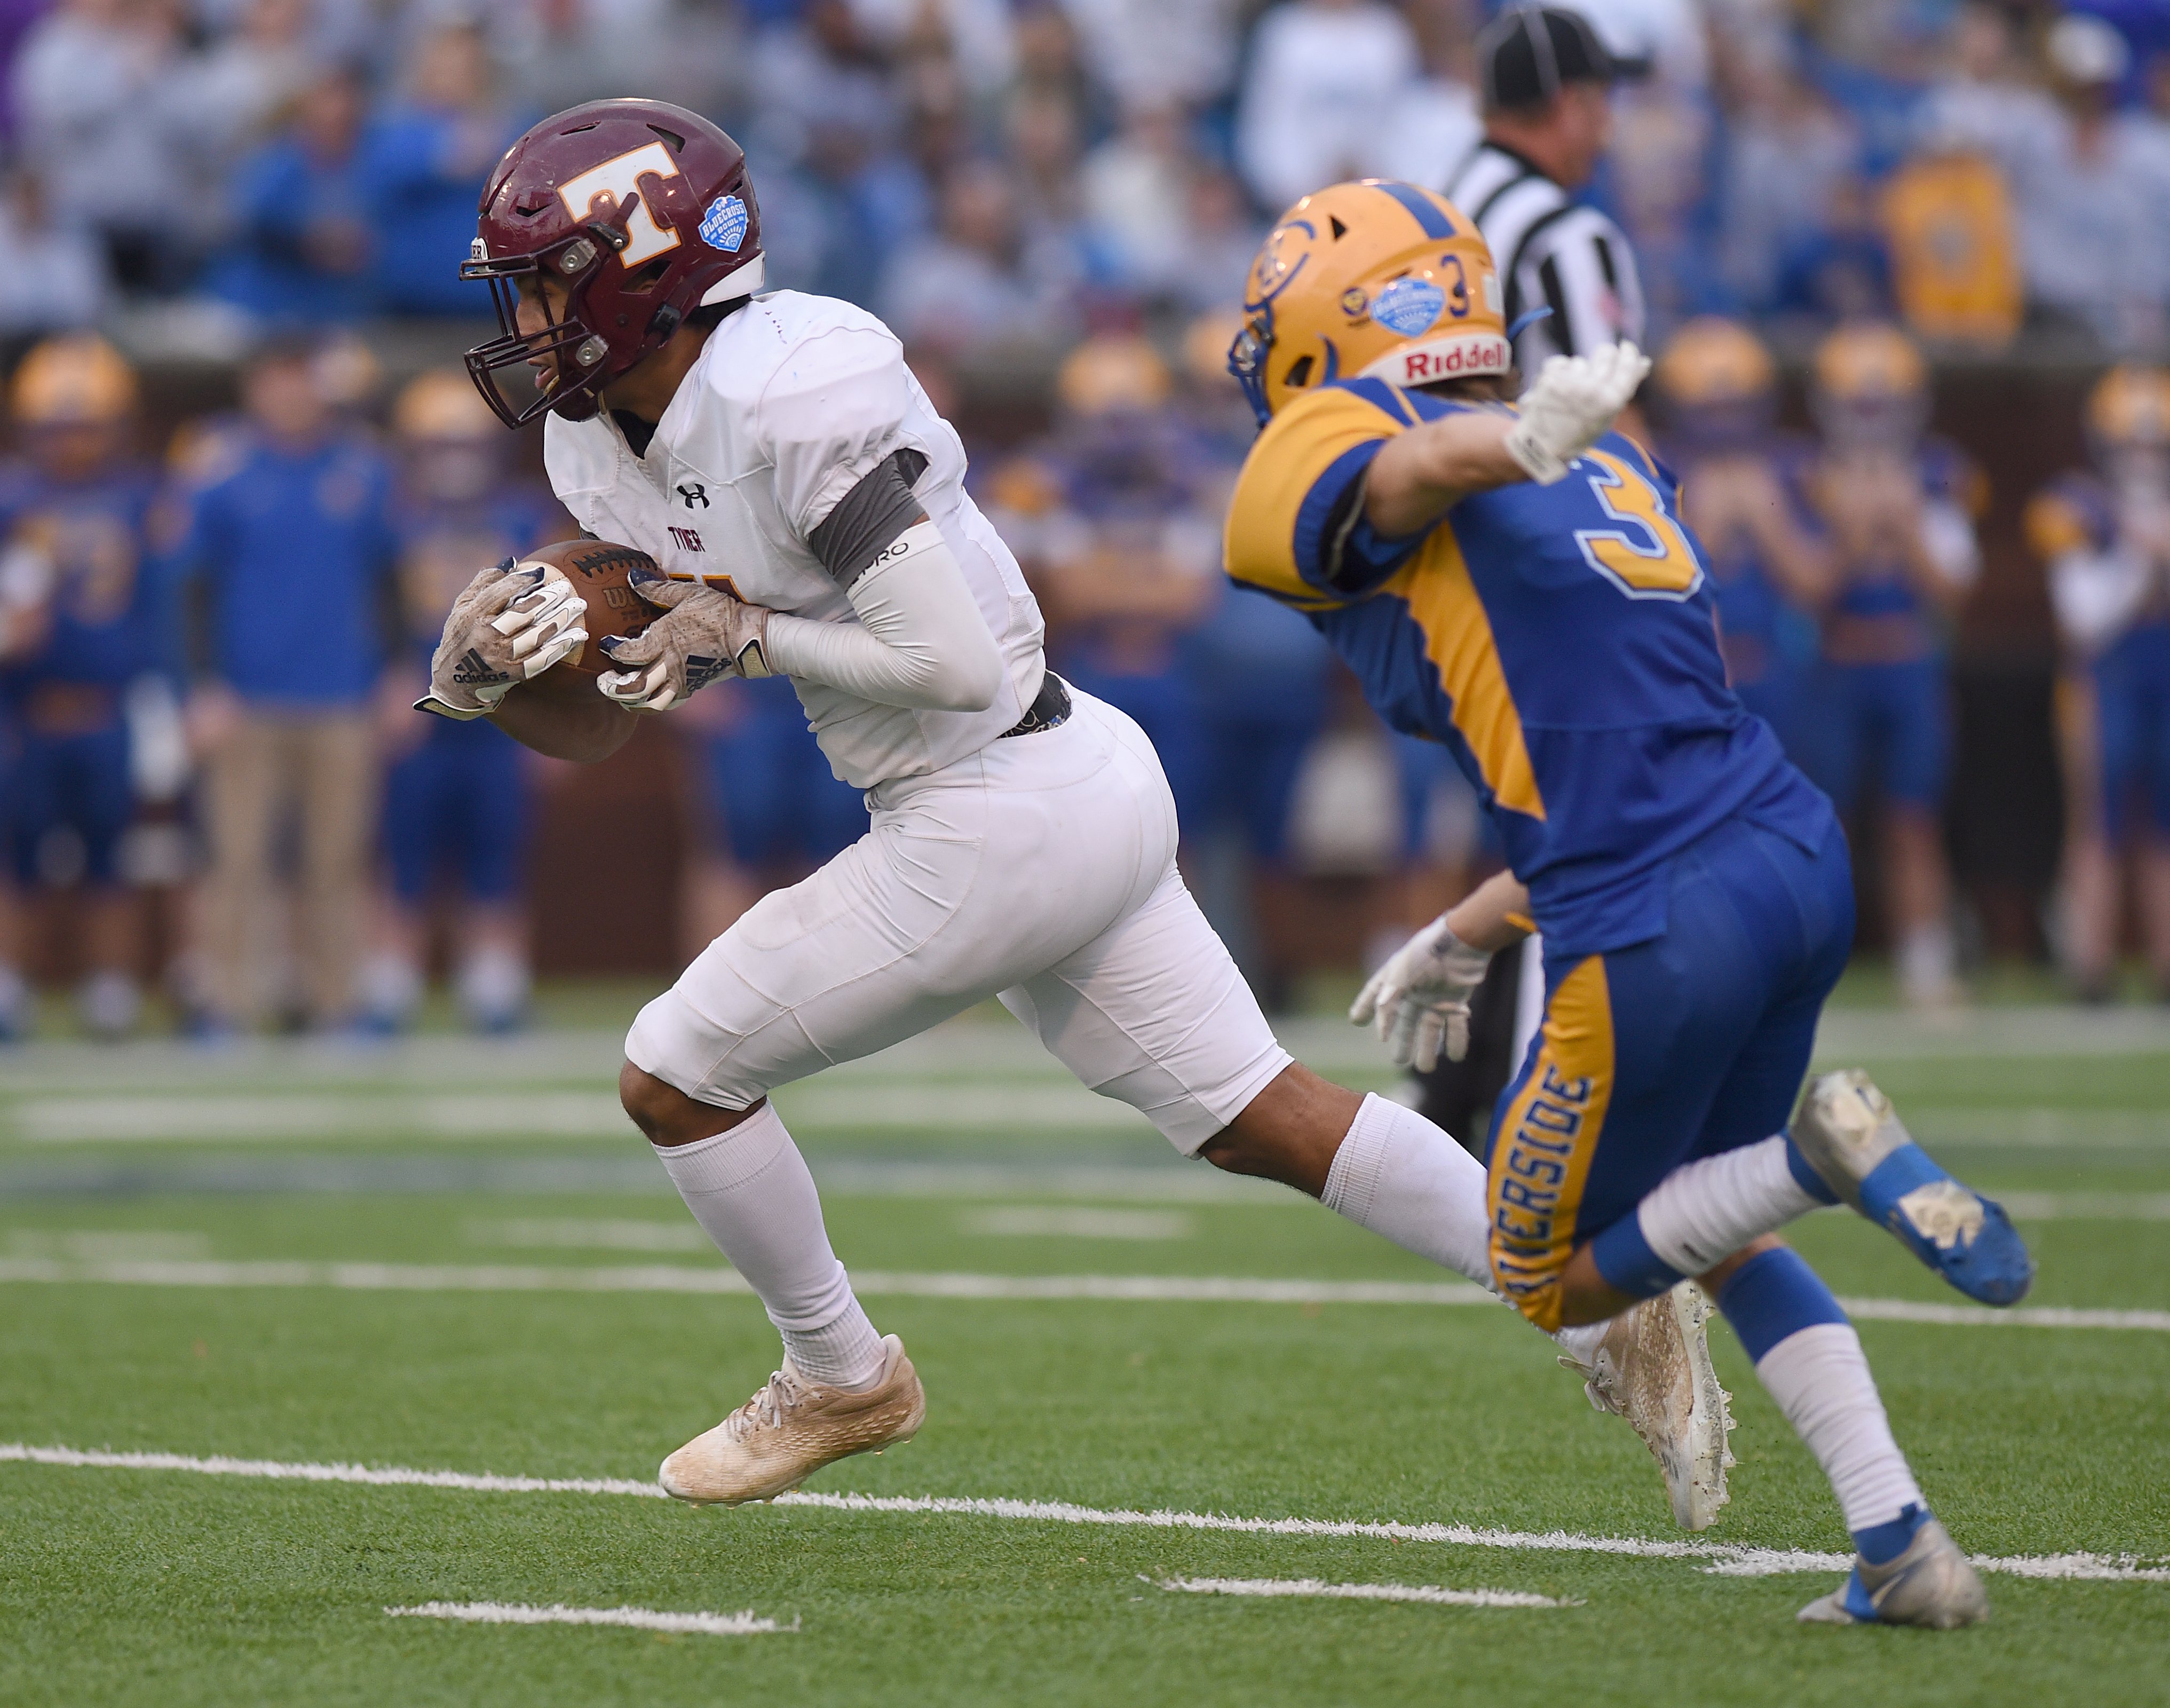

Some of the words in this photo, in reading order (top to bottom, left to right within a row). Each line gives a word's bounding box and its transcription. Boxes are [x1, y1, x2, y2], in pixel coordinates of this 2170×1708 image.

[557, 140, 683, 269] T
[702, 204, 744, 238] BLUECROSS
[718, 218, 738, 234] BOWL
[1440, 254, 1470, 317] 3
[1569, 447, 1705, 603] 3
[454, 671, 509, 683] adidas
